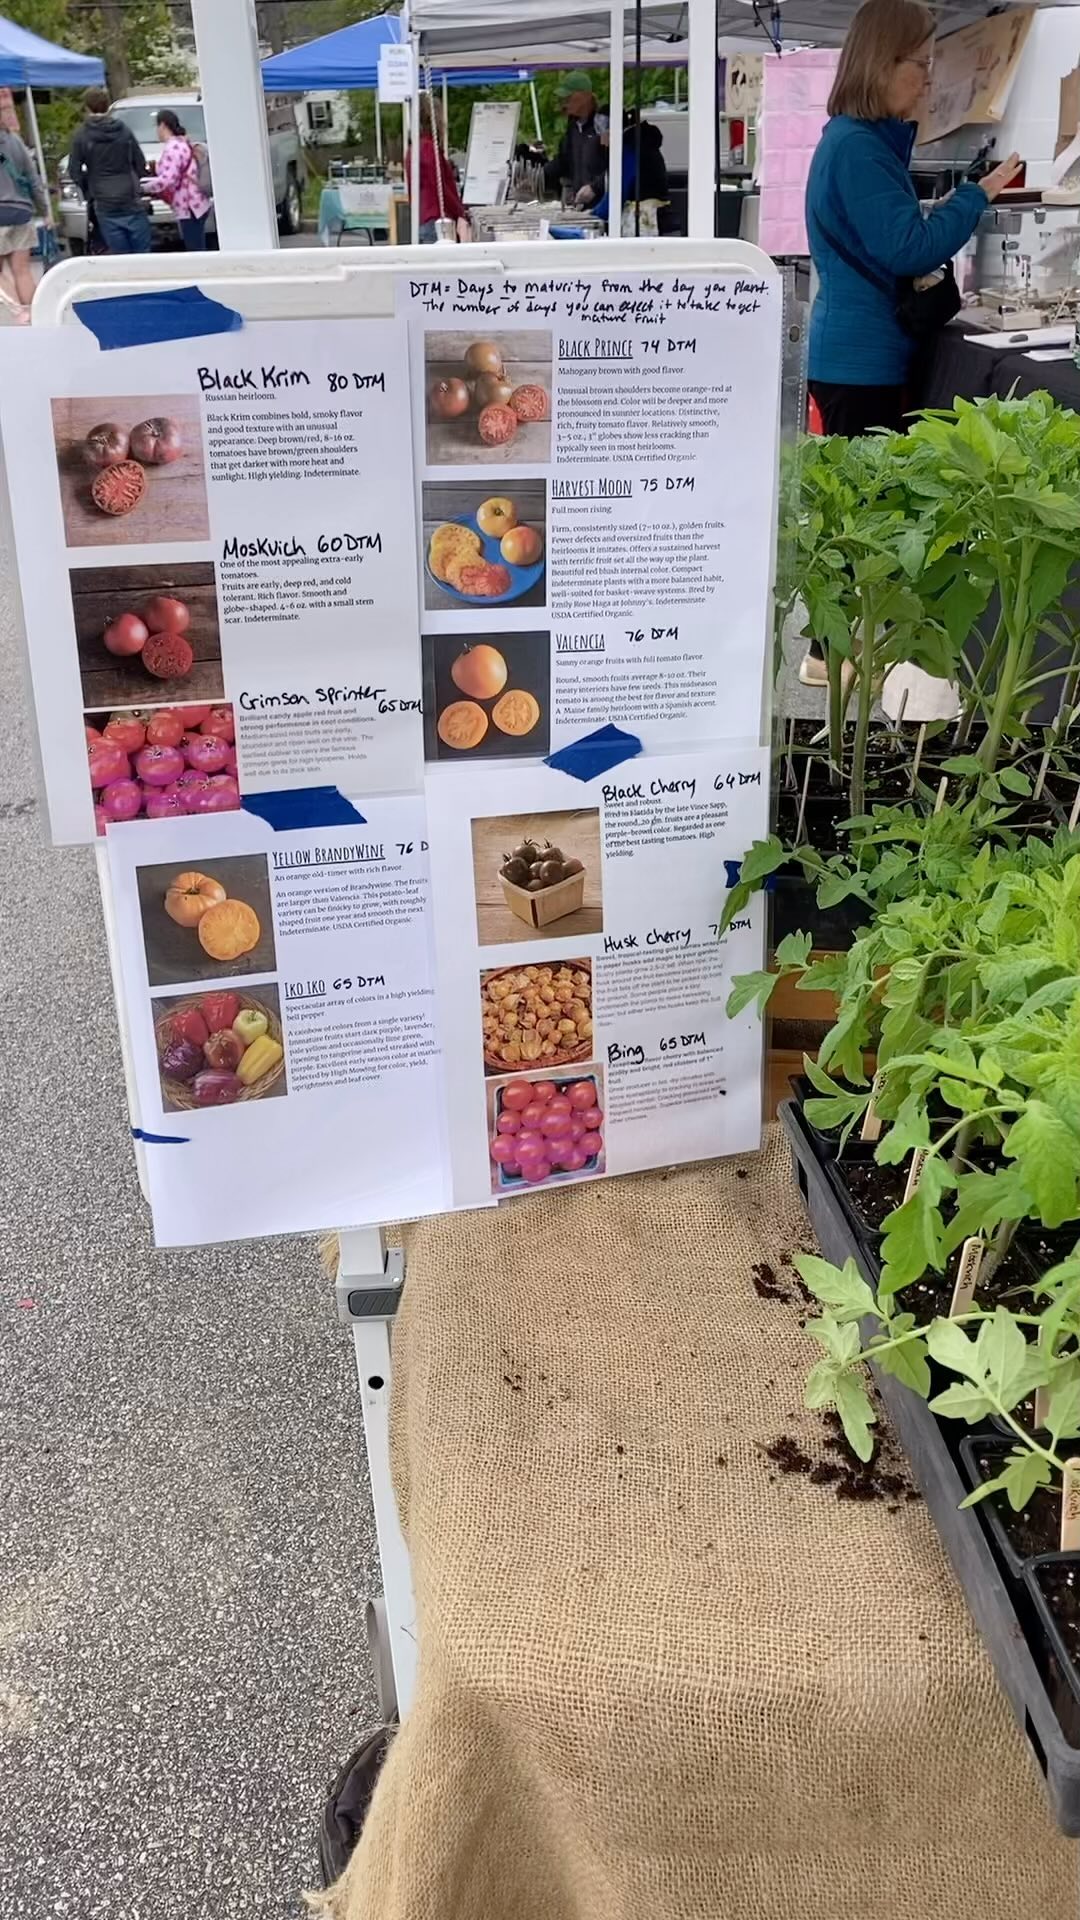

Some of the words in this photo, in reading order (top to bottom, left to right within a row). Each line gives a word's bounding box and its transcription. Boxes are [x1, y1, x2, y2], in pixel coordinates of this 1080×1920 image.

[458, 278, 494, 302] Days
[503, 279, 517, 294] to
[524, 278, 592, 303] maturity
[603, 280, 632, 294] from
[639, 279, 663, 293] the
[672, 279, 694, 298] day
[704, 284, 726, 298] you
[423, 301, 445, 311] The
[452, 298, 501, 314] number
[507, 299, 520, 314] of
[526, 298, 558, 313] days
[566, 301, 589, 314] you
[594, 302, 615, 312] can
[660, 299, 674, 311] it
[677, 297, 688, 311] to
[690, 299, 719, 311] take
[725, 300, 737, 311] to
[738, 301, 761, 313] get
[581, 313, 627, 324] mature
[641, 340, 660, 355] 74
[667, 339, 697, 354] DTM
[198, 367, 257, 392] Black
[262, 366, 310, 388] Krim
[327, 372, 346, 392] 80
[353, 372, 385, 392] DTM
[205, 394, 237, 402] Russian
[238, 392, 277, 402] heirloom.
[557, 386, 589, 395] Unusual
[589, 386, 614, 395] brown
[614, 386, 651, 394] shoulders
[652, 386, 681, 394] become
[681, 385, 724, 396] orange-red
[725, 385, 732, 393] at
[206, 414, 229, 422] Black
[230, 413, 251, 422] Krim
[251, 412, 290, 421] combines
[291, 412, 311, 422] bold,
[312, 411, 339, 422] smoky
[339, 410, 363, 419] flavor
[207, 426, 223, 434] and
[224, 425, 245, 436] good
[245, 425, 275, 434] texture
[275, 424, 294, 433] with
[306, 423, 338, 432] unusual
[209, 449, 247, 458] tomatoes
[247, 448, 267, 457] have
[267, 447, 319, 458] brown/green
[320, 446, 358, 455] shoulders
[556, 444, 589, 454] typically
[608, 443, 616, 451] in
[616, 443, 636, 451] most
[210, 461, 227, 470] that
[228, 461, 241, 471] get
[242, 460, 268, 469] darker
[269, 460, 288, 468] with
[289, 460, 310, 468] more
[311, 458, 328, 467] heat
[329, 458, 345, 466] and
[640, 478, 658, 492] 75
[666, 477, 695, 492] DTM
[551, 507, 566, 515] Full
[551, 536, 574, 544] Fewer
[574, 535, 601, 543] defects
[602, 535, 616, 543] and
[616, 534, 652, 542] oversized
[652, 534, 673, 542] fruits
[674, 533, 691, 541] than
[692, 533, 704, 541] the
[219, 561, 236, 569] One
[236, 560, 245, 568] of
[246, 560, 260, 568] the
[260, 559, 281, 567] most
[282, 557, 320, 568] appealing
[320, 555, 364, 567] extra-early
[220, 571, 259, 580] tomatoes.
[221, 583, 246, 591] Fruits
[260, 581, 282, 592] early,
[283, 580, 302, 591] deep
[303, 579, 318, 590] red,
[319, 579, 334, 587] and
[335, 578, 352, 586] cold
[222, 593, 258, 602] tolerant.
[257, 592, 275, 600] Rich
[276, 591, 302, 600] flavor.
[301, 589, 332, 598] Smooth
[332, 588, 348, 597] and
[625, 629, 644, 642] 76
[651, 627, 679, 640] DTM
[239, 692, 310, 711] Crimson
[316, 686, 386, 704] Sprinter
[378, 699, 395, 714] 65
[399, 699, 423, 713] DTM
[602, 784, 645, 802] Black
[651, 778, 696, 798] Cherry
[714, 775, 735, 790] 64
[739, 772, 761, 785] DTM
[396, 842, 413, 855] 76
[277, 908, 302, 919] variety
[327, 904, 352, 915] finicky
[361, 902, 382, 912] grow,
[382, 899, 399, 908] with
[399, 897, 427, 908] roughly
[604, 935, 639, 953] Husk
[646, 928, 691, 948] Cherry
[730, 919, 751, 930] DTM
[333, 978, 352, 990] 65
[358, 975, 385, 987] DTM
[607, 1043, 645, 1064] Bing
[659, 1037, 677, 1051] 65
[681, 1033, 706, 1047] DTM
